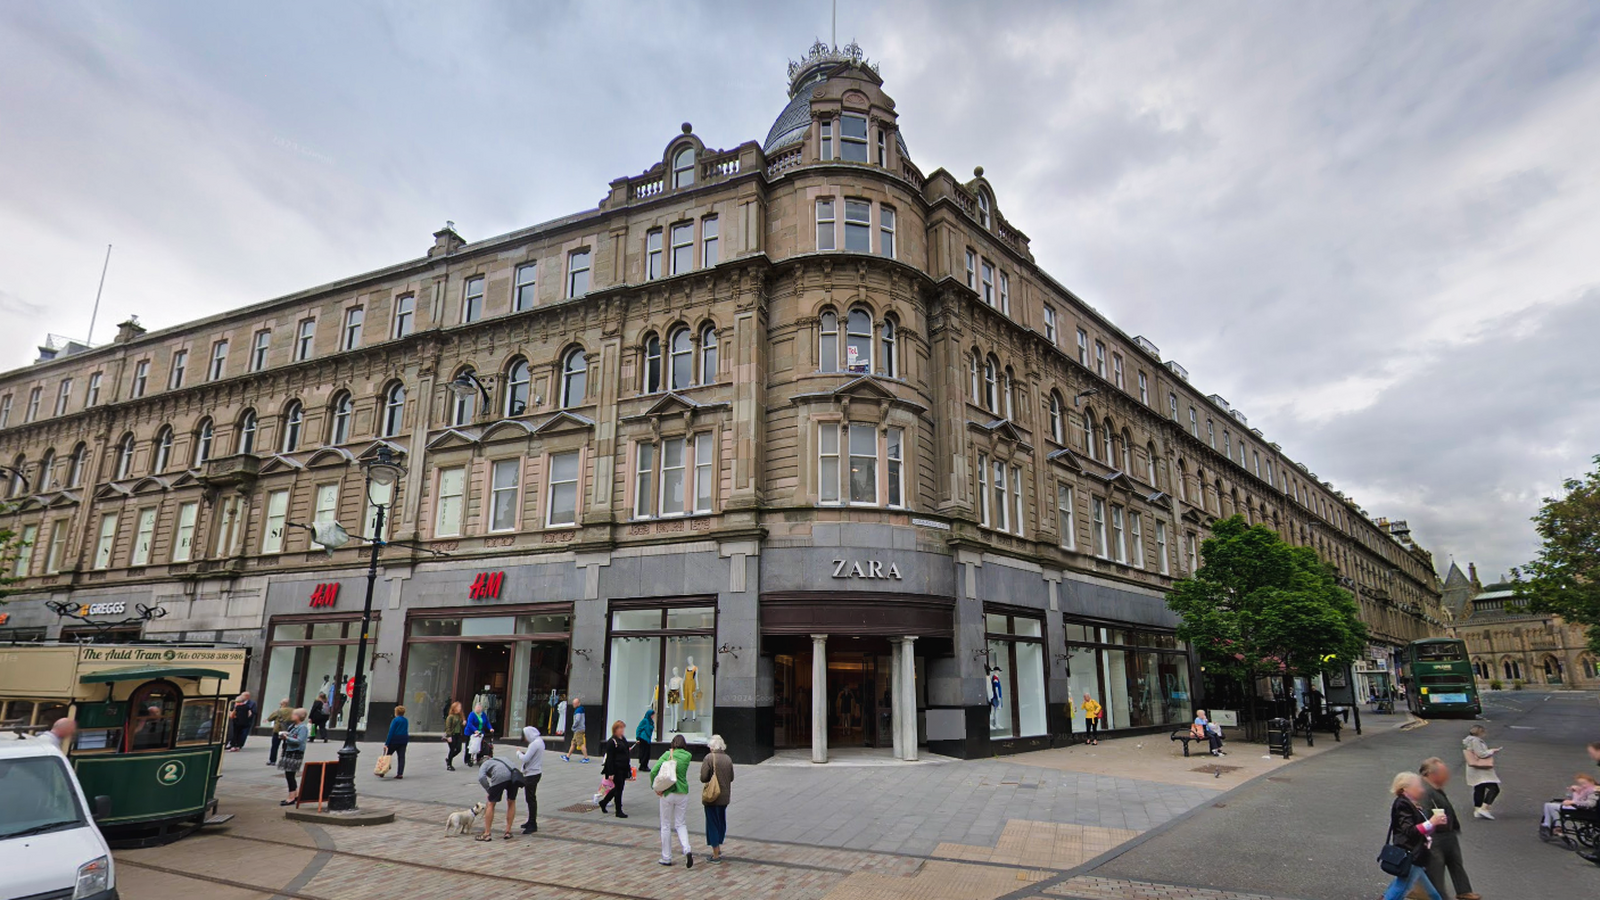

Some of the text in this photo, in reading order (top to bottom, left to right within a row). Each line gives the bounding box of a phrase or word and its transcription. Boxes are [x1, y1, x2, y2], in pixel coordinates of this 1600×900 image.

[832, 559, 902, 580] ZARA
[309, 582, 340, 607] H&M
[468, 570, 505, 600] H&M
[89, 601, 126, 615] GREGGS
[82, 648, 103, 660] The
[104, 648, 133, 661] Auld
[134, 649, 161, 660] Tram
[164, 764, 178, 781] 2
